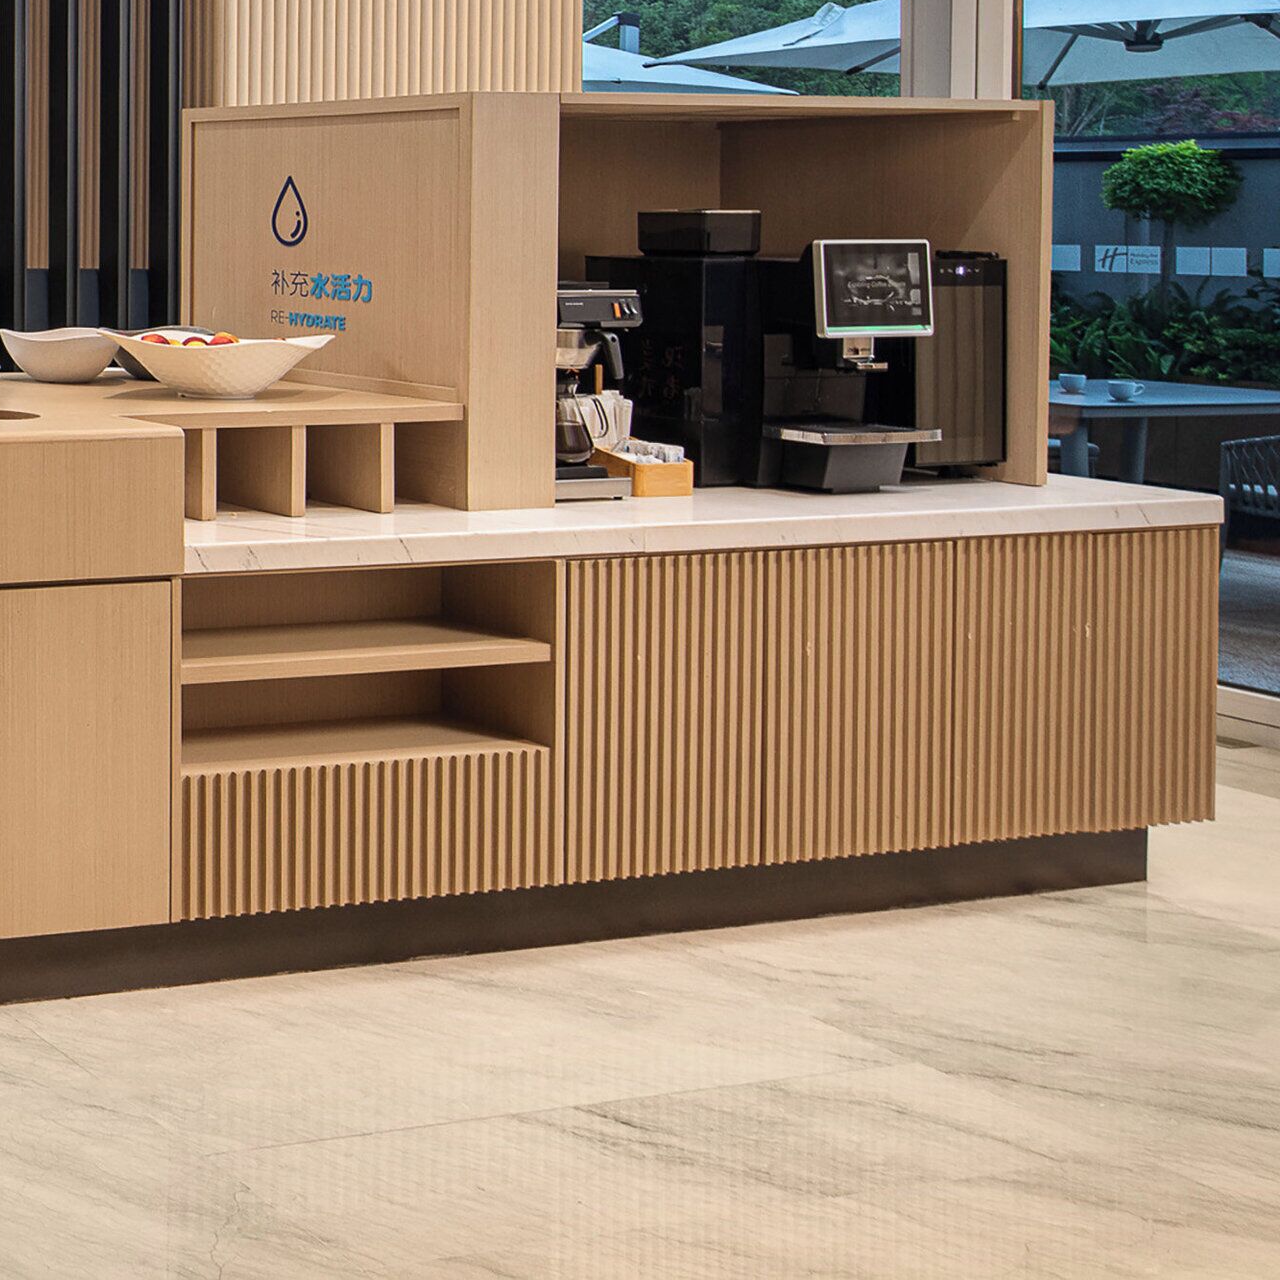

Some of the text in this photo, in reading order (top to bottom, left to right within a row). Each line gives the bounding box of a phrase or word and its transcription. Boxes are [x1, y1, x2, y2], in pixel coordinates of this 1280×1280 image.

[271, 269, 373, 303] 补充水活力
[270, 309, 347, 331] RE-HYDRATE
